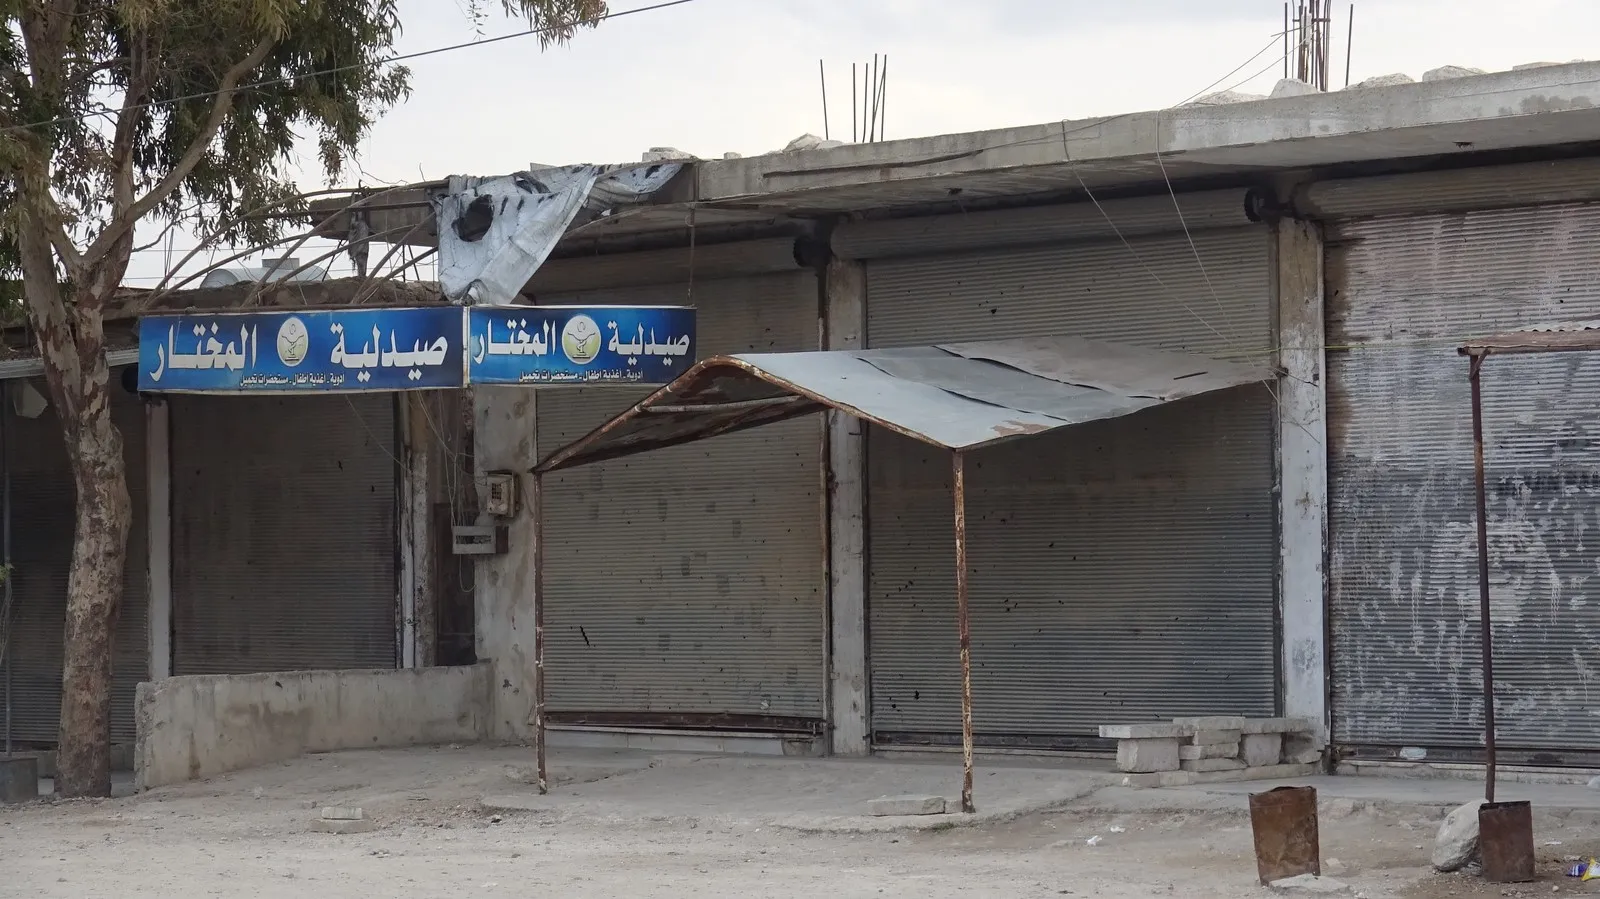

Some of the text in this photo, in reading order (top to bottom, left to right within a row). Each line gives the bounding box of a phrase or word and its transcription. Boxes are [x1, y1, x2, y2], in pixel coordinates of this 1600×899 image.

[149, 321, 449, 382] صيدلية المختار
[472, 318, 691, 366] صيدلية المختار
